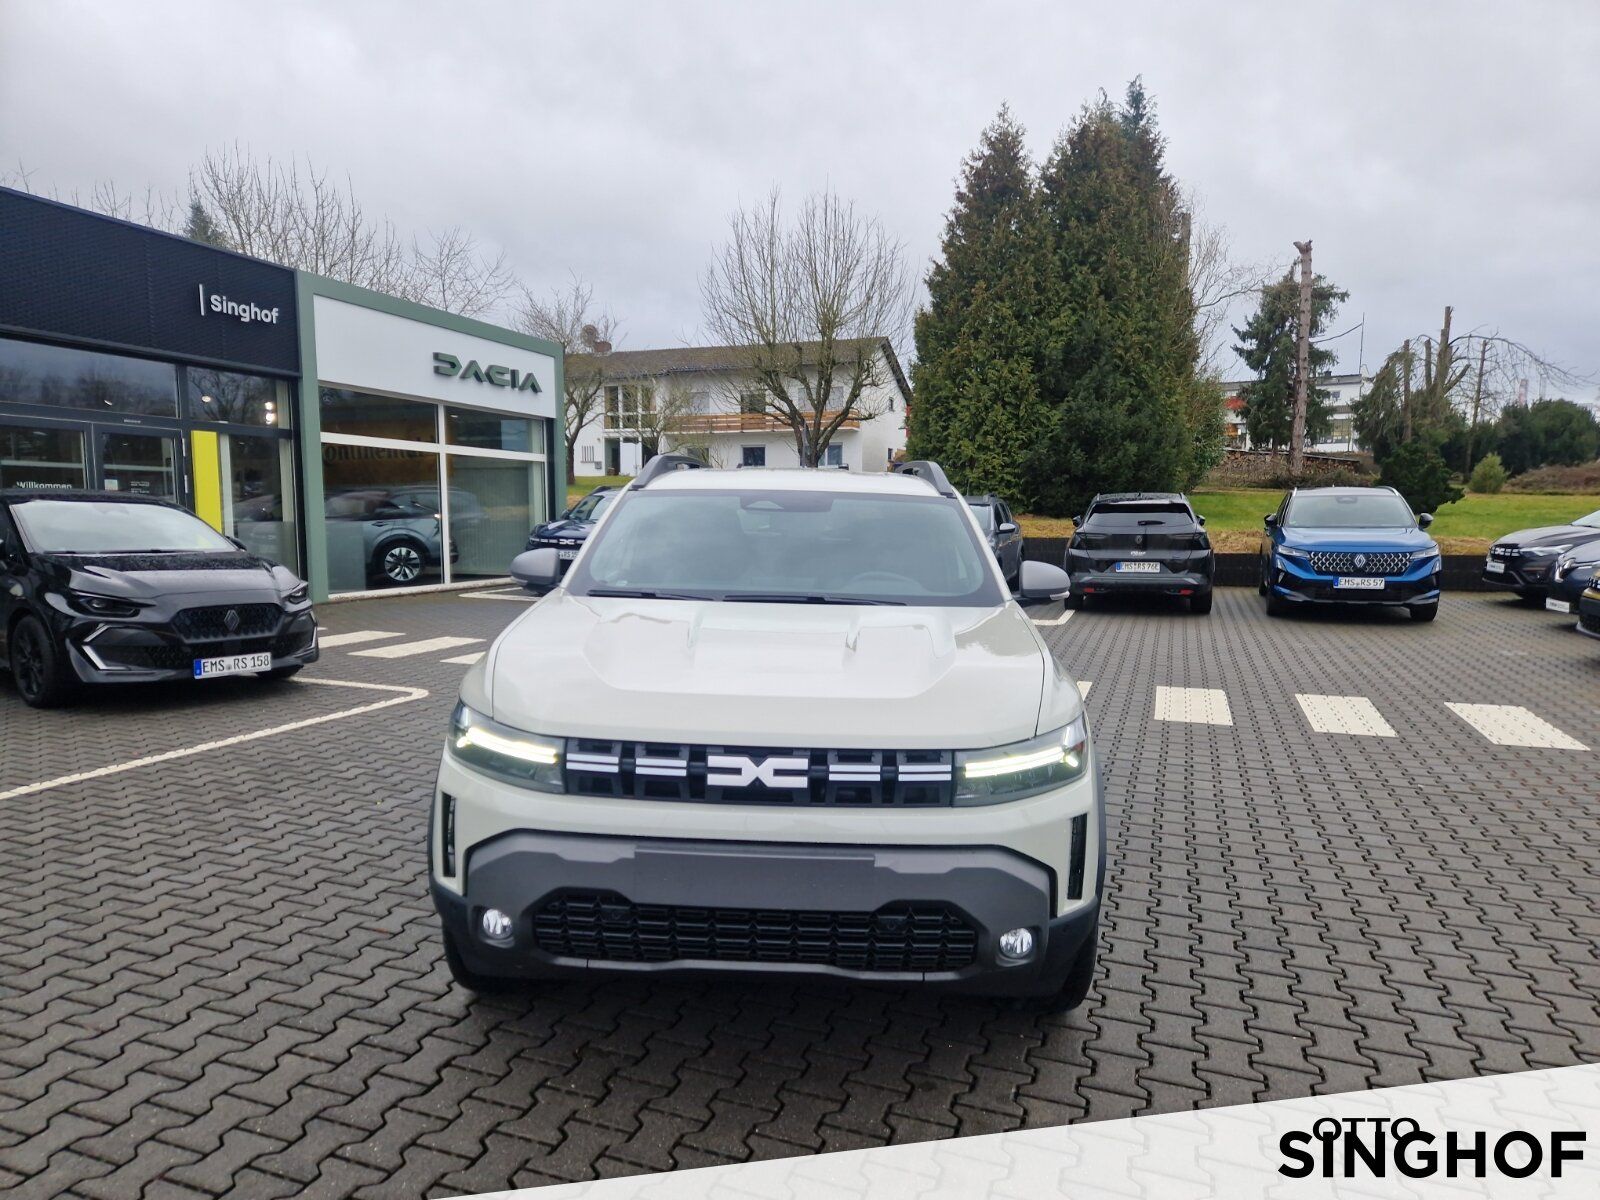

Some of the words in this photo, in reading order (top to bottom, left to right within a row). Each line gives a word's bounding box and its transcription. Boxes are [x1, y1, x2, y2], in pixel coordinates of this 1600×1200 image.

[210, 294, 279, 324] Singhof
[432, 351, 542, 393] DACIA
[1339, 578, 1356, 586] EMS
[1372, 579, 1384, 587] 57
[202, 659, 225, 673] EMS
[233, 657, 248, 670] RS
[250, 654, 270, 668] 158
